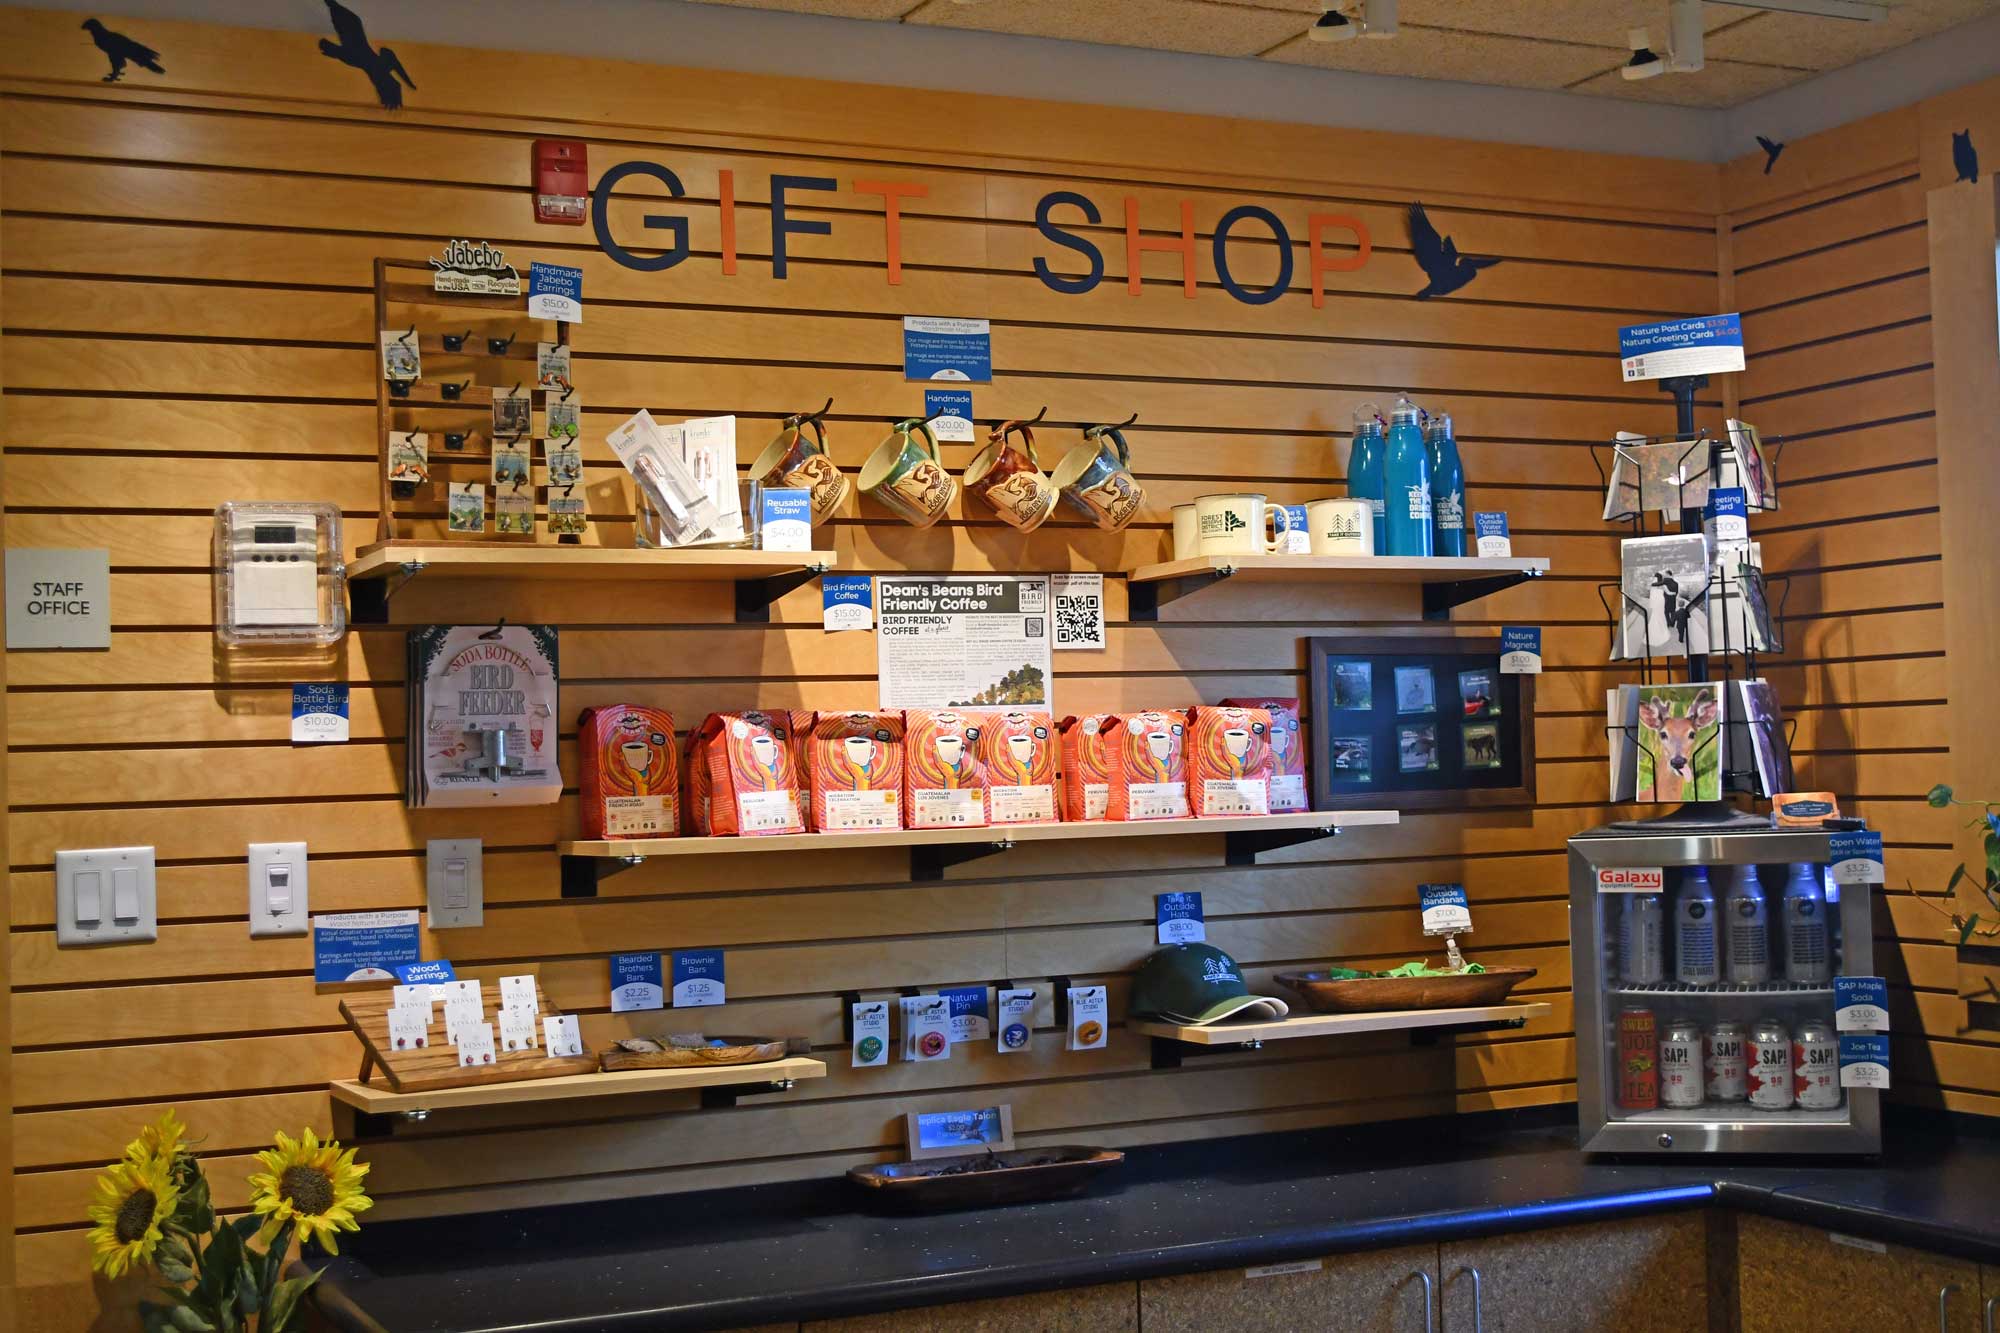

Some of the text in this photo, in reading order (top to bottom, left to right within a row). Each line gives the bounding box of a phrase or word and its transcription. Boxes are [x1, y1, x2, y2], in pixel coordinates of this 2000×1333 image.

[591, 161, 1372, 309] GIFT SHOP
[446, 241, 502, 267] Jabebo
[531, 264, 583, 279] Handmade
[487, 280, 520, 289] Recycled
[538, 274, 574, 286] Jabebo
[451, 283, 470, 292] USA
[537, 283, 575, 297] Earrings
[542, 297, 569, 309] $15.00
[1630, 326, 1660, 337] Nature
[1661, 323, 1681, 335] Post
[1681, 321, 1705, 331] Cards
[1622, 337, 1651, 348] Nature
[1652, 332, 1689, 345] Greeting
[1690, 330, 1714, 340] Cards
[927, 394, 970, 403] Handmade
[935, 421, 965, 430] $20.00
[767, 498, 808, 508] Reusable
[1409, 497, 1422, 505] THE
[774, 506, 801, 515] Straw
[1714, 502, 1734, 511] Card
[1438, 521, 1463, 529] COMING
[1478, 518, 1504, 526] Outside
[33, 582, 84, 597] STAFF
[823, 583, 872, 593] Bird Friendly
[882, 583, 1003, 598] Dean's Beans Bird
[834, 591, 860, 600] Coffee
[1021, 592, 1043, 600] BIRD
[27, 600, 90, 616] OFFICE
[882, 597, 988, 613] Friendly Coffee
[833, 608, 862, 618] $15.00
[882, 615, 953, 625] BIRD FRIENDLY
[882, 626, 920, 636] COFFEE
[1507, 631, 1534, 640] Nature
[1504, 641, 1537, 651] Magnets
[484, 645, 530, 672] BOTTLE
[470, 664, 515, 690] BIRD
[308, 685, 335, 694] Soda
[293, 694, 349, 704] Bottle Bird
[458, 690, 526, 716] FEEDER
[302, 703, 339, 713] Feeder
[303, 717, 338, 726] $10.00
[1829, 837, 1881, 848] Open Water
[1844, 863, 1872, 873] $3.25
[1599, 870, 1661, 888] Galaxy
[1166, 894, 1192, 904] Take it
[1425, 890, 1458, 899] Outside
[1423, 896, 1465, 906] Bandanas
[1163, 902, 1196, 912] Outside
[325, 913, 357, 921] Products
[380, 911, 409, 920] Purpose
[1170, 910, 1190, 919] Hats
[1434, 908, 1457, 919] $7.00
[335, 934, 360, 942] business
[618, 955, 653, 965] Bearded
[681, 956, 716, 966] Brownie
[408, 963, 440, 975] Wood
[618, 964, 654, 974] Brothers
[688, 966, 707, 974] Bars
[407, 971, 450, 983] Earrings
[626, 974, 645, 982] Bars
[687, 983, 711, 994] $1.25
[1838, 982, 1883, 991] SAP Maple
[624, 987, 650, 999] $2.25
[949, 993, 979, 1003] Nature
[1851, 993, 1873, 1002] Soda
[955, 1001, 972, 1010] Pin
[1849, 1009, 1877, 1019] $3.00
[951, 1018, 977, 1028] $3.00
[1716, 1042, 1741, 1057] SAP!
[1850, 1042, 1881, 1052] Joe Tea
[1664, 1047, 1688, 1063] SAP!
[1763, 1049, 1787, 1065] SAP!
[1809, 1048, 1834, 1065] SAP!
[1624, 1082, 1654, 1099] TEA
[947, 1111, 997, 1125] Eagle Talon
